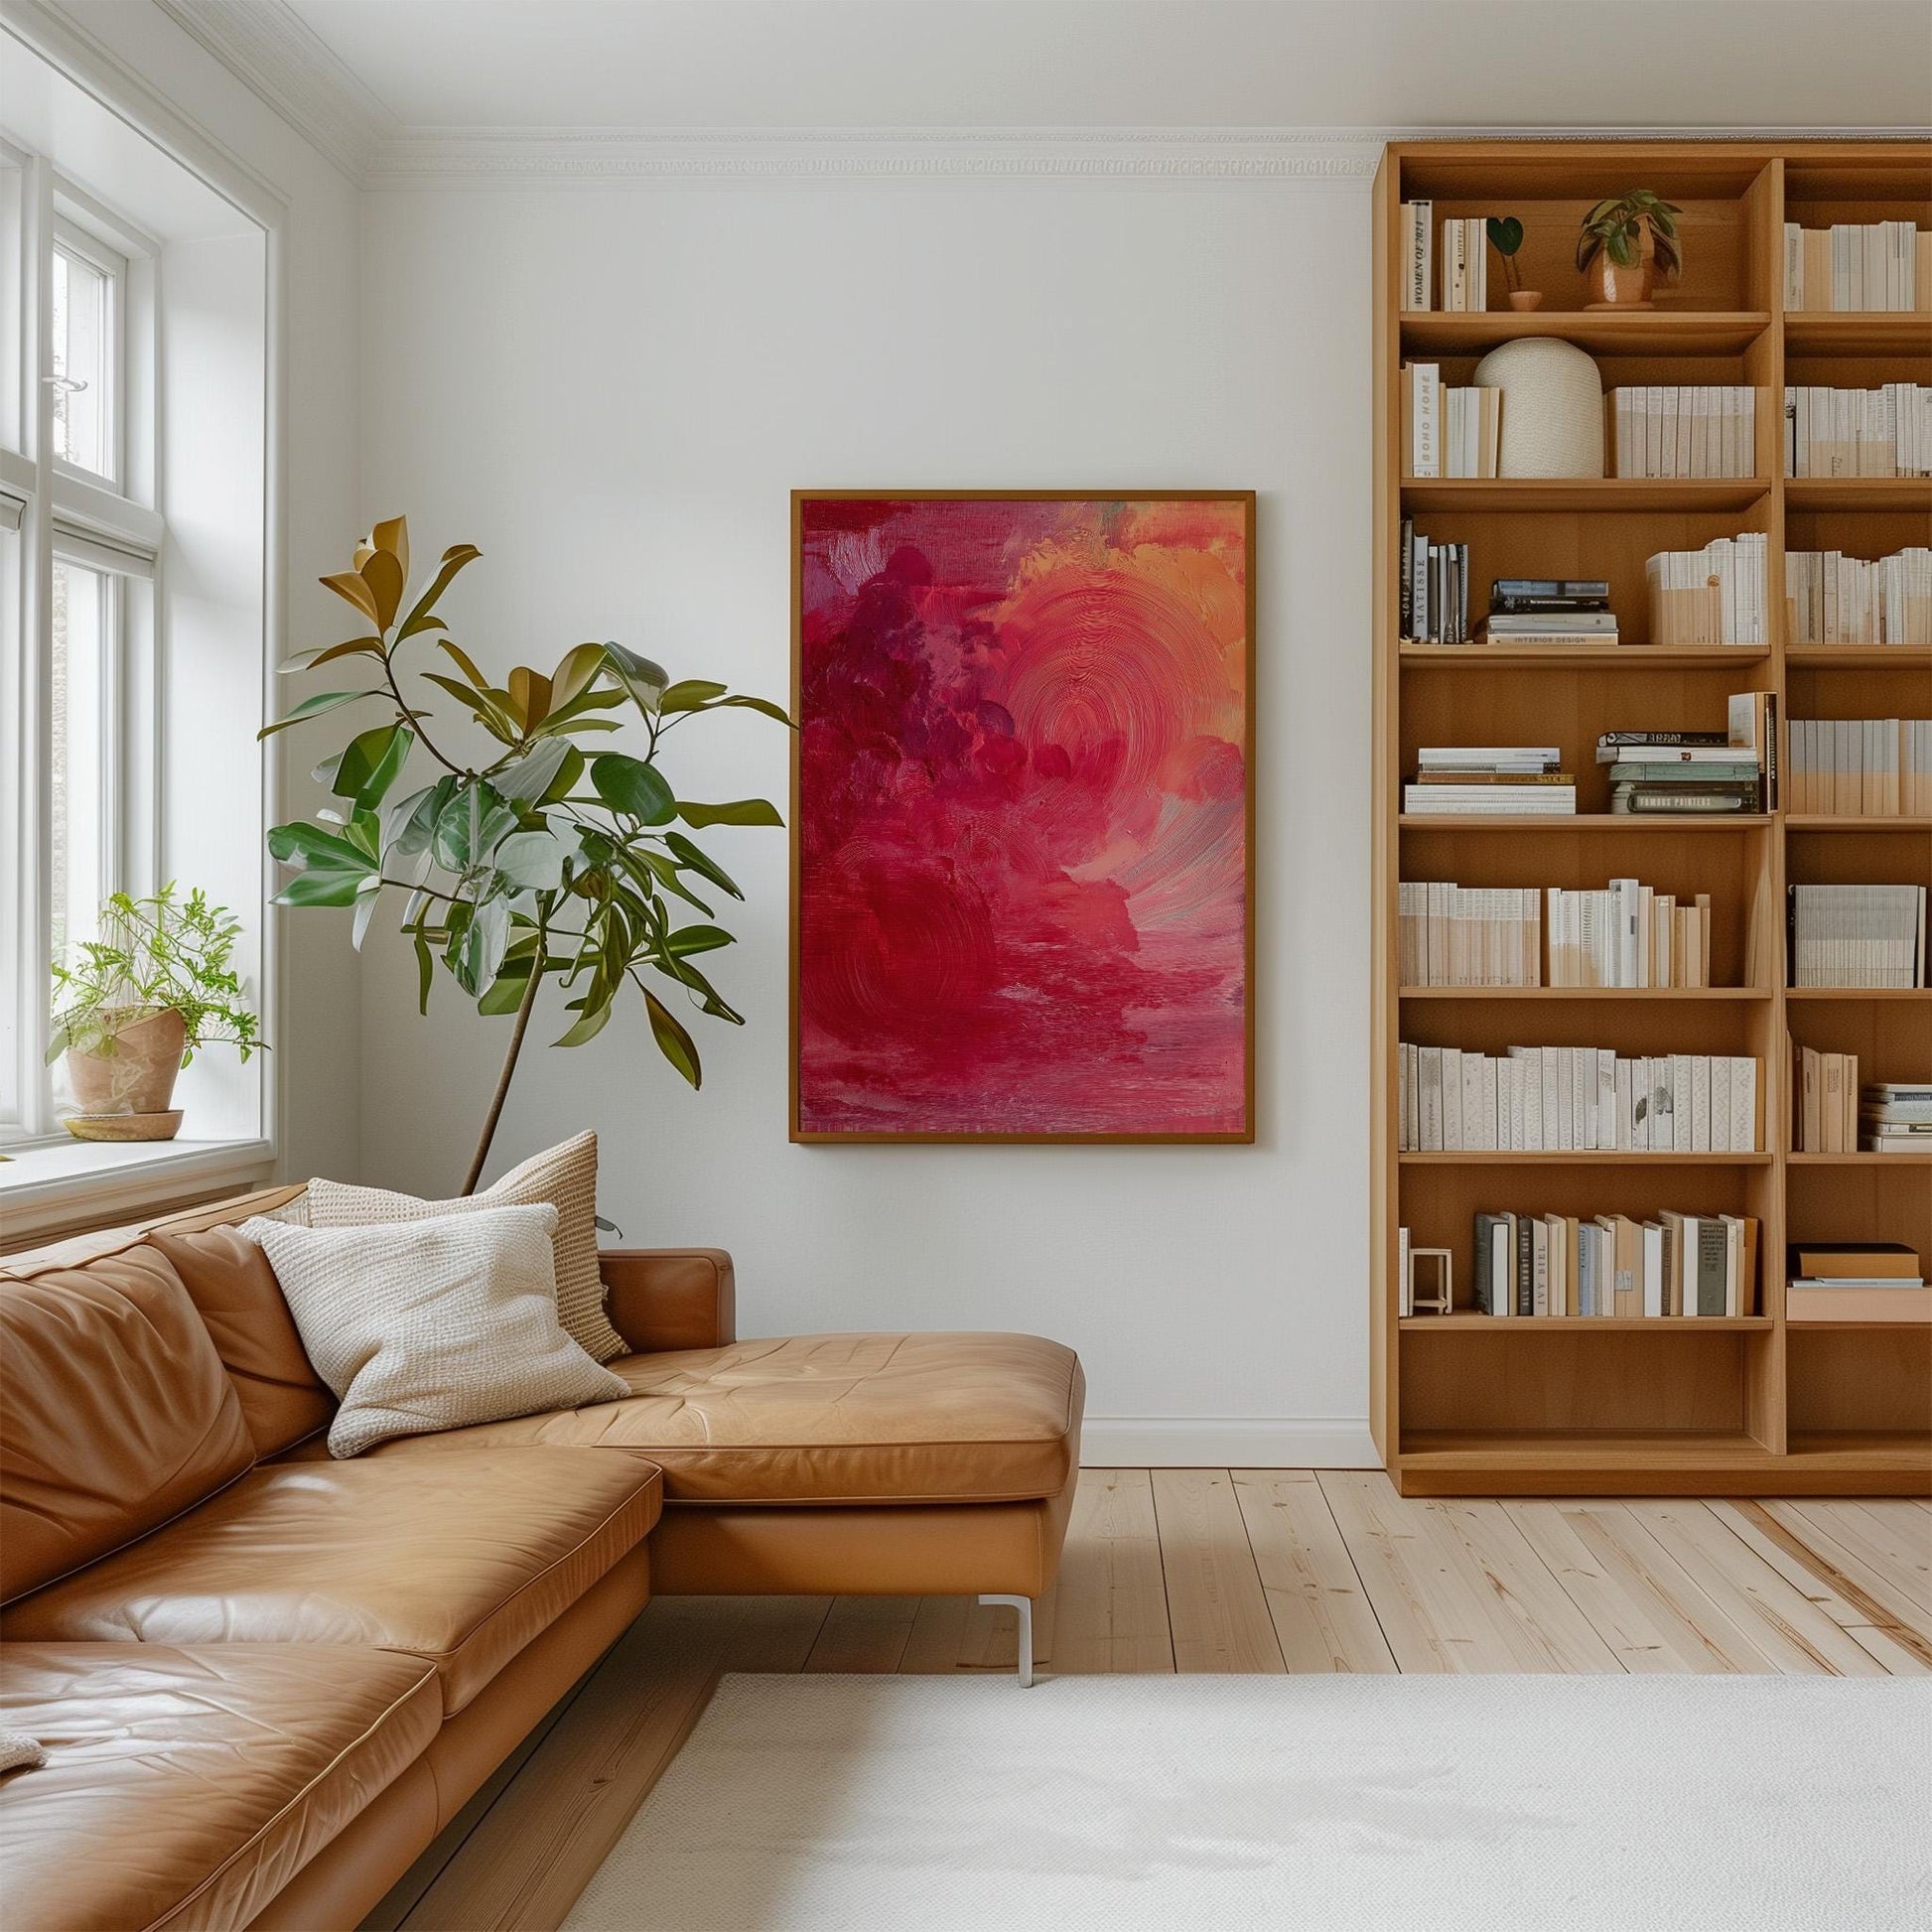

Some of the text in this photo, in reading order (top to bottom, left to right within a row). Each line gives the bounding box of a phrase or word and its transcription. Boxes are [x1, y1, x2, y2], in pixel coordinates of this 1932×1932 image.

[1414, 245, 1424, 260] OF
[1414, 261, 1423, 305] WOMEN
[1421, 374, 1430, 462] BOHO HOME
[1416, 559, 1425, 623] MATISSE
[1640, 797, 1712, 807] FAMOUS PAINTERS
